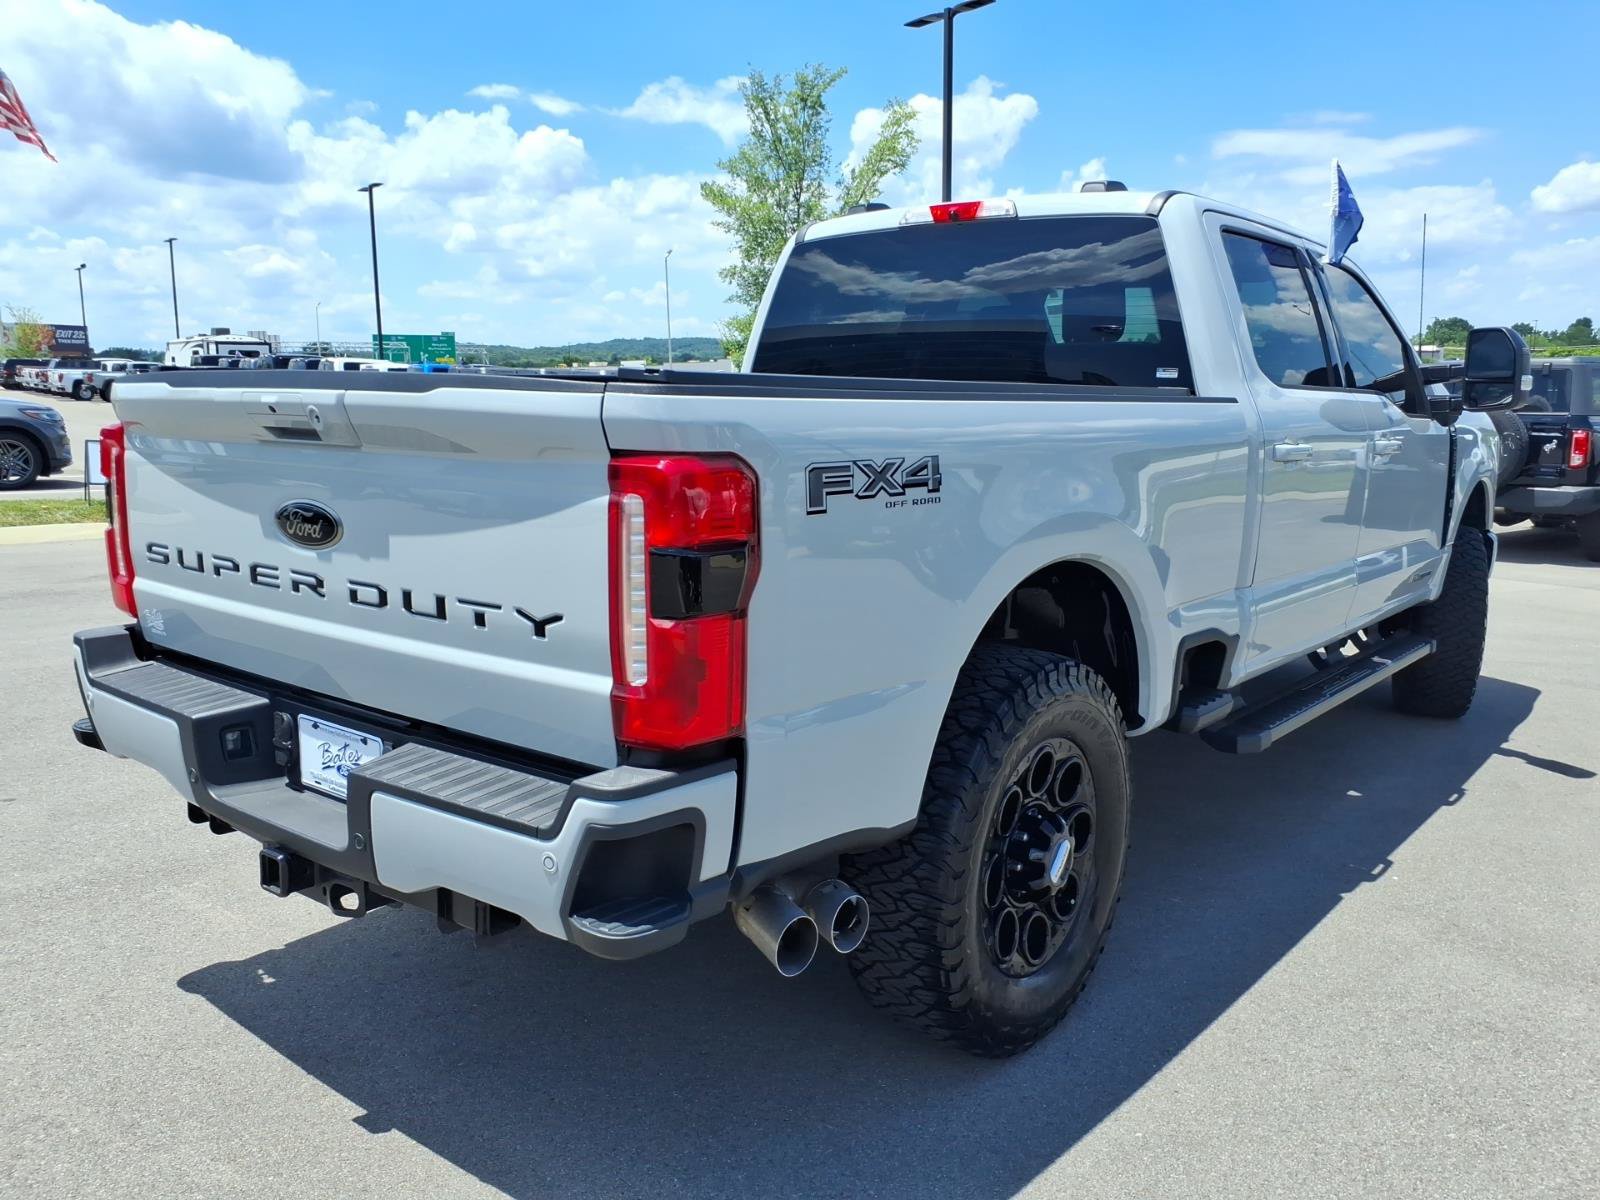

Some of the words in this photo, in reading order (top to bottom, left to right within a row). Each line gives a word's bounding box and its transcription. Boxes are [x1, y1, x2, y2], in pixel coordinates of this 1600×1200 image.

[56, 330, 73, 338] EXIT
[805, 454, 942, 516] FX4
[885, 501, 908, 509] OFF
[912, 496, 941, 506] ROAD
[286, 508, 323, 539] Ford
[145, 541, 327, 600] SUPER
[347, 578, 566, 641] DUTY
[318, 742, 362, 765] Bates
